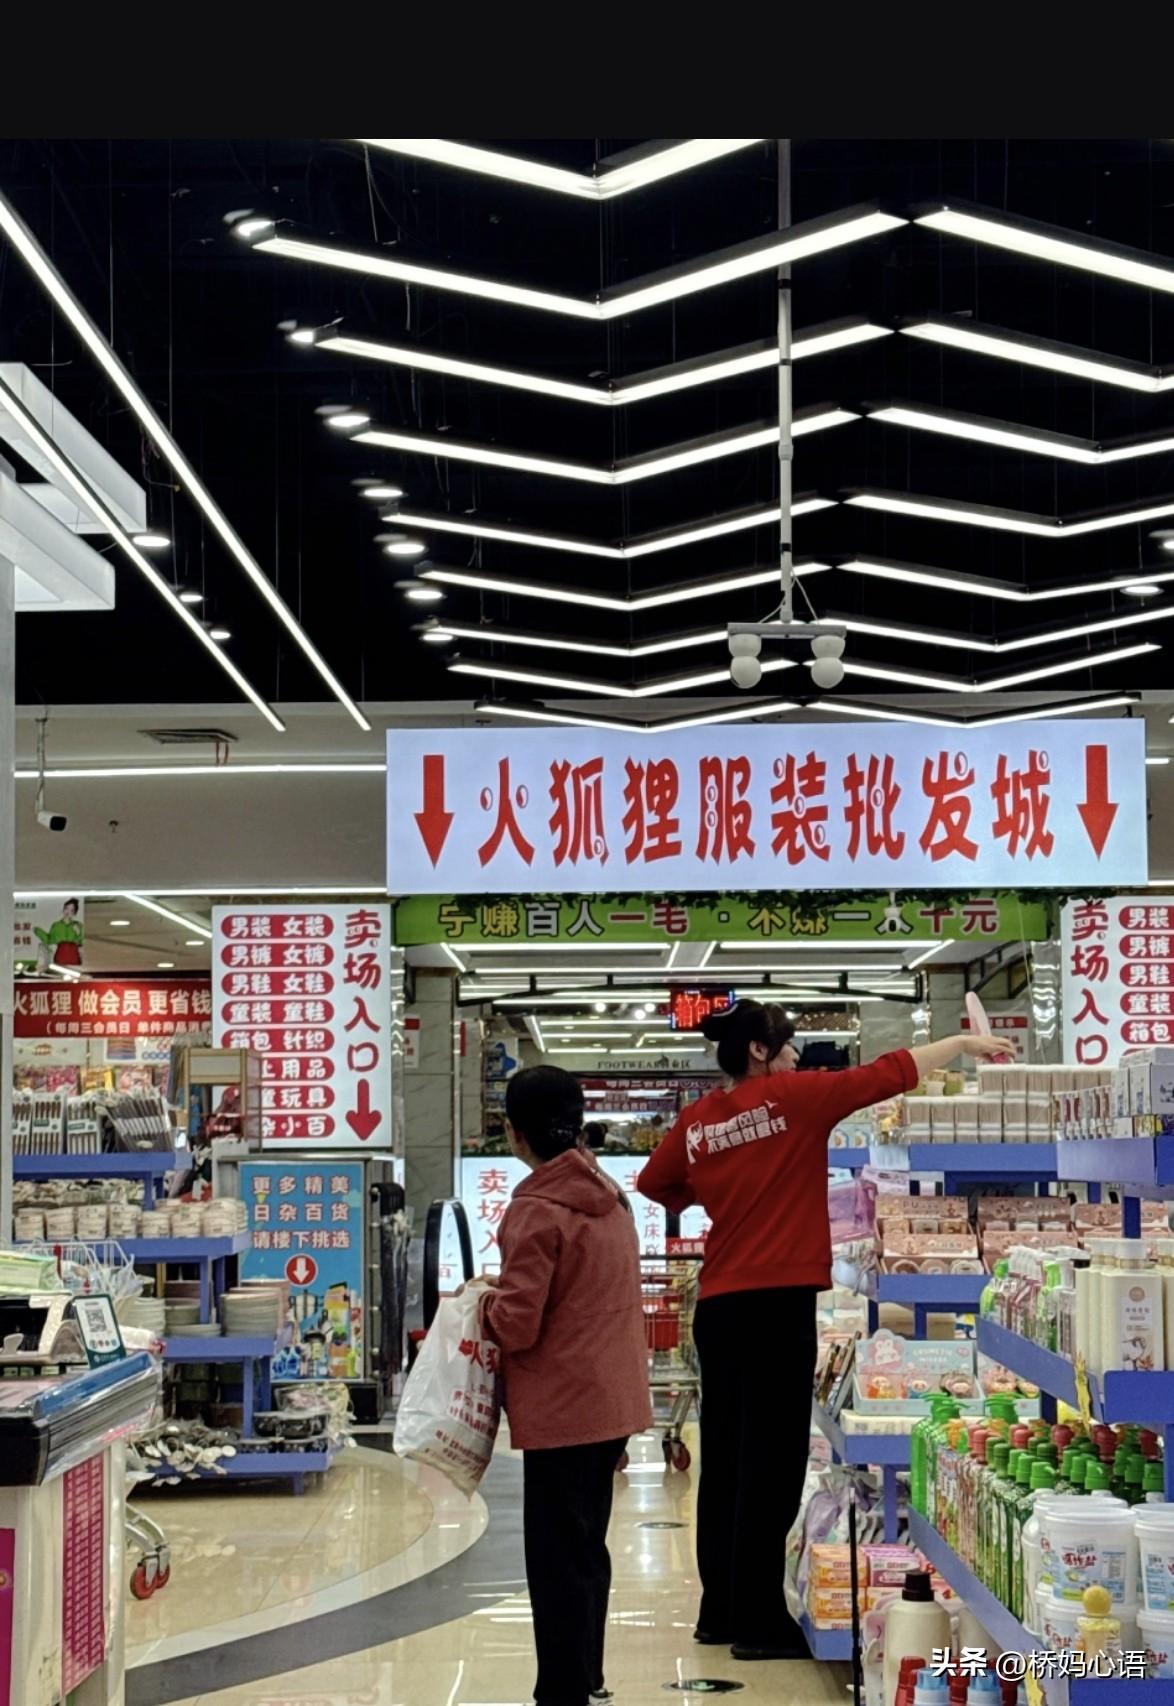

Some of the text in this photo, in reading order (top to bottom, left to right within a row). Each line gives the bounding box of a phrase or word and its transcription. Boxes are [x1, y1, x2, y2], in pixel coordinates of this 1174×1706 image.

[478, 750, 1055, 868] 火狐狸服装批发城
[229, 915, 325, 937] 男装 女装
[1127, 907, 1170, 929] 男装
[229, 944, 326, 966] 男裤 女裤
[1127, 936, 1170, 957] 男裤
[229, 972, 326, 995] 男鞋 女鞋
[1071, 899, 1110, 1065] 卖场入口
[1127, 965, 1170, 986] 男鞋
[343, 909, 382, 1072] 卖场入口
[14, 989, 212, 1016] 火狐狸 做会员 更省钱
[229, 1001, 326, 1023] 童装 童鞋
[1128, 993, 1171, 1014] 童装
[229, 1030, 326, 1050] 箱包 针织
[1129, 1022, 1172, 1043] 箱包
[261, 1058, 326, 1079] 上用品
[261, 1087, 326, 1108] 童玩具
[261, 1116, 327, 1136] 杂小百
[253, 1175, 349, 1195] 更多精美
[254, 1203, 349, 1222] 日杂百货
[253, 1230, 350, 1249] 请楼下挑选
